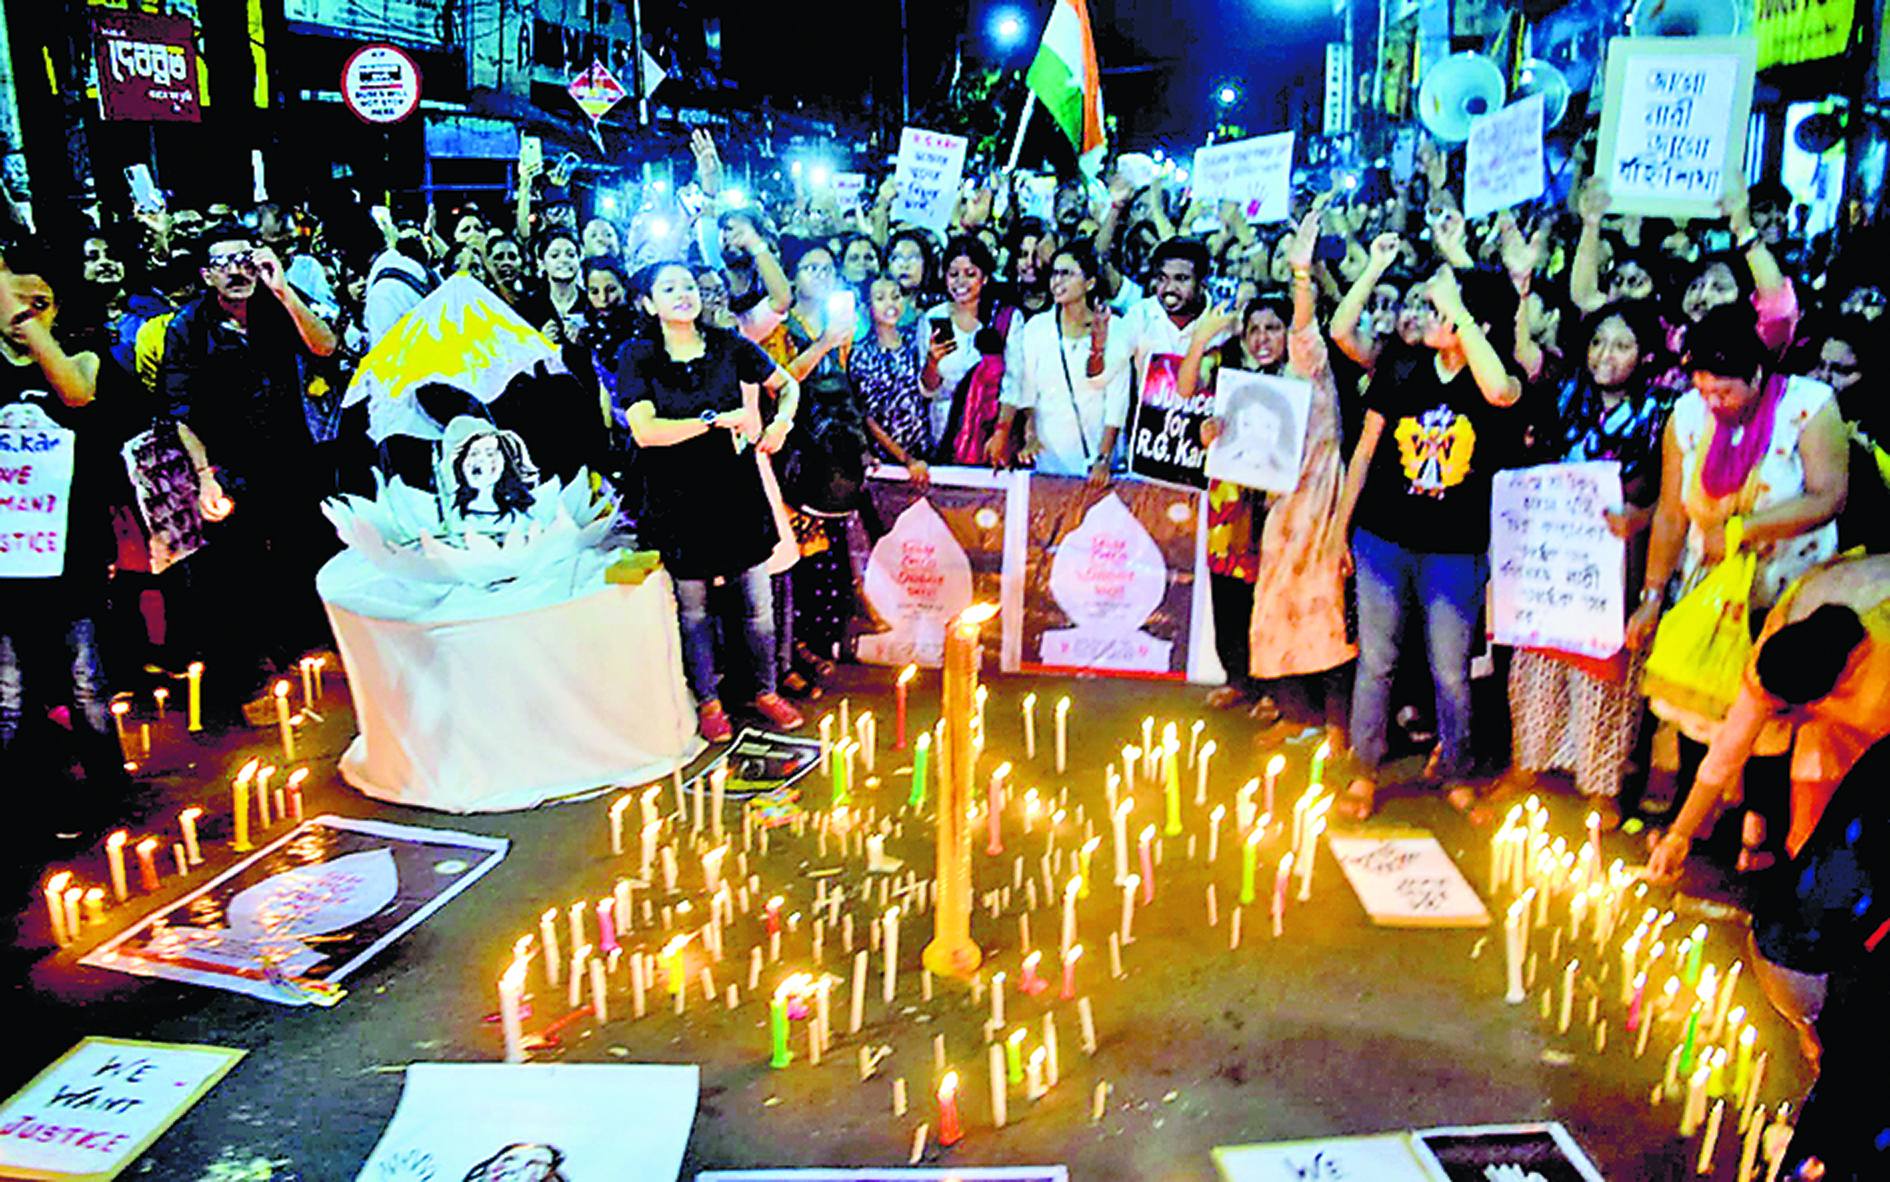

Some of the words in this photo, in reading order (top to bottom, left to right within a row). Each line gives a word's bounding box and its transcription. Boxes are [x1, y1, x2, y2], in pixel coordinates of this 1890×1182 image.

[1164, 409, 1190, 438] for
[1173, 438, 1206, 468] Kar
[93, 1056, 158, 1084] WE
[45, 1085, 143, 1114] WANT
[0, 1116, 130, 1152] JUSTICE
